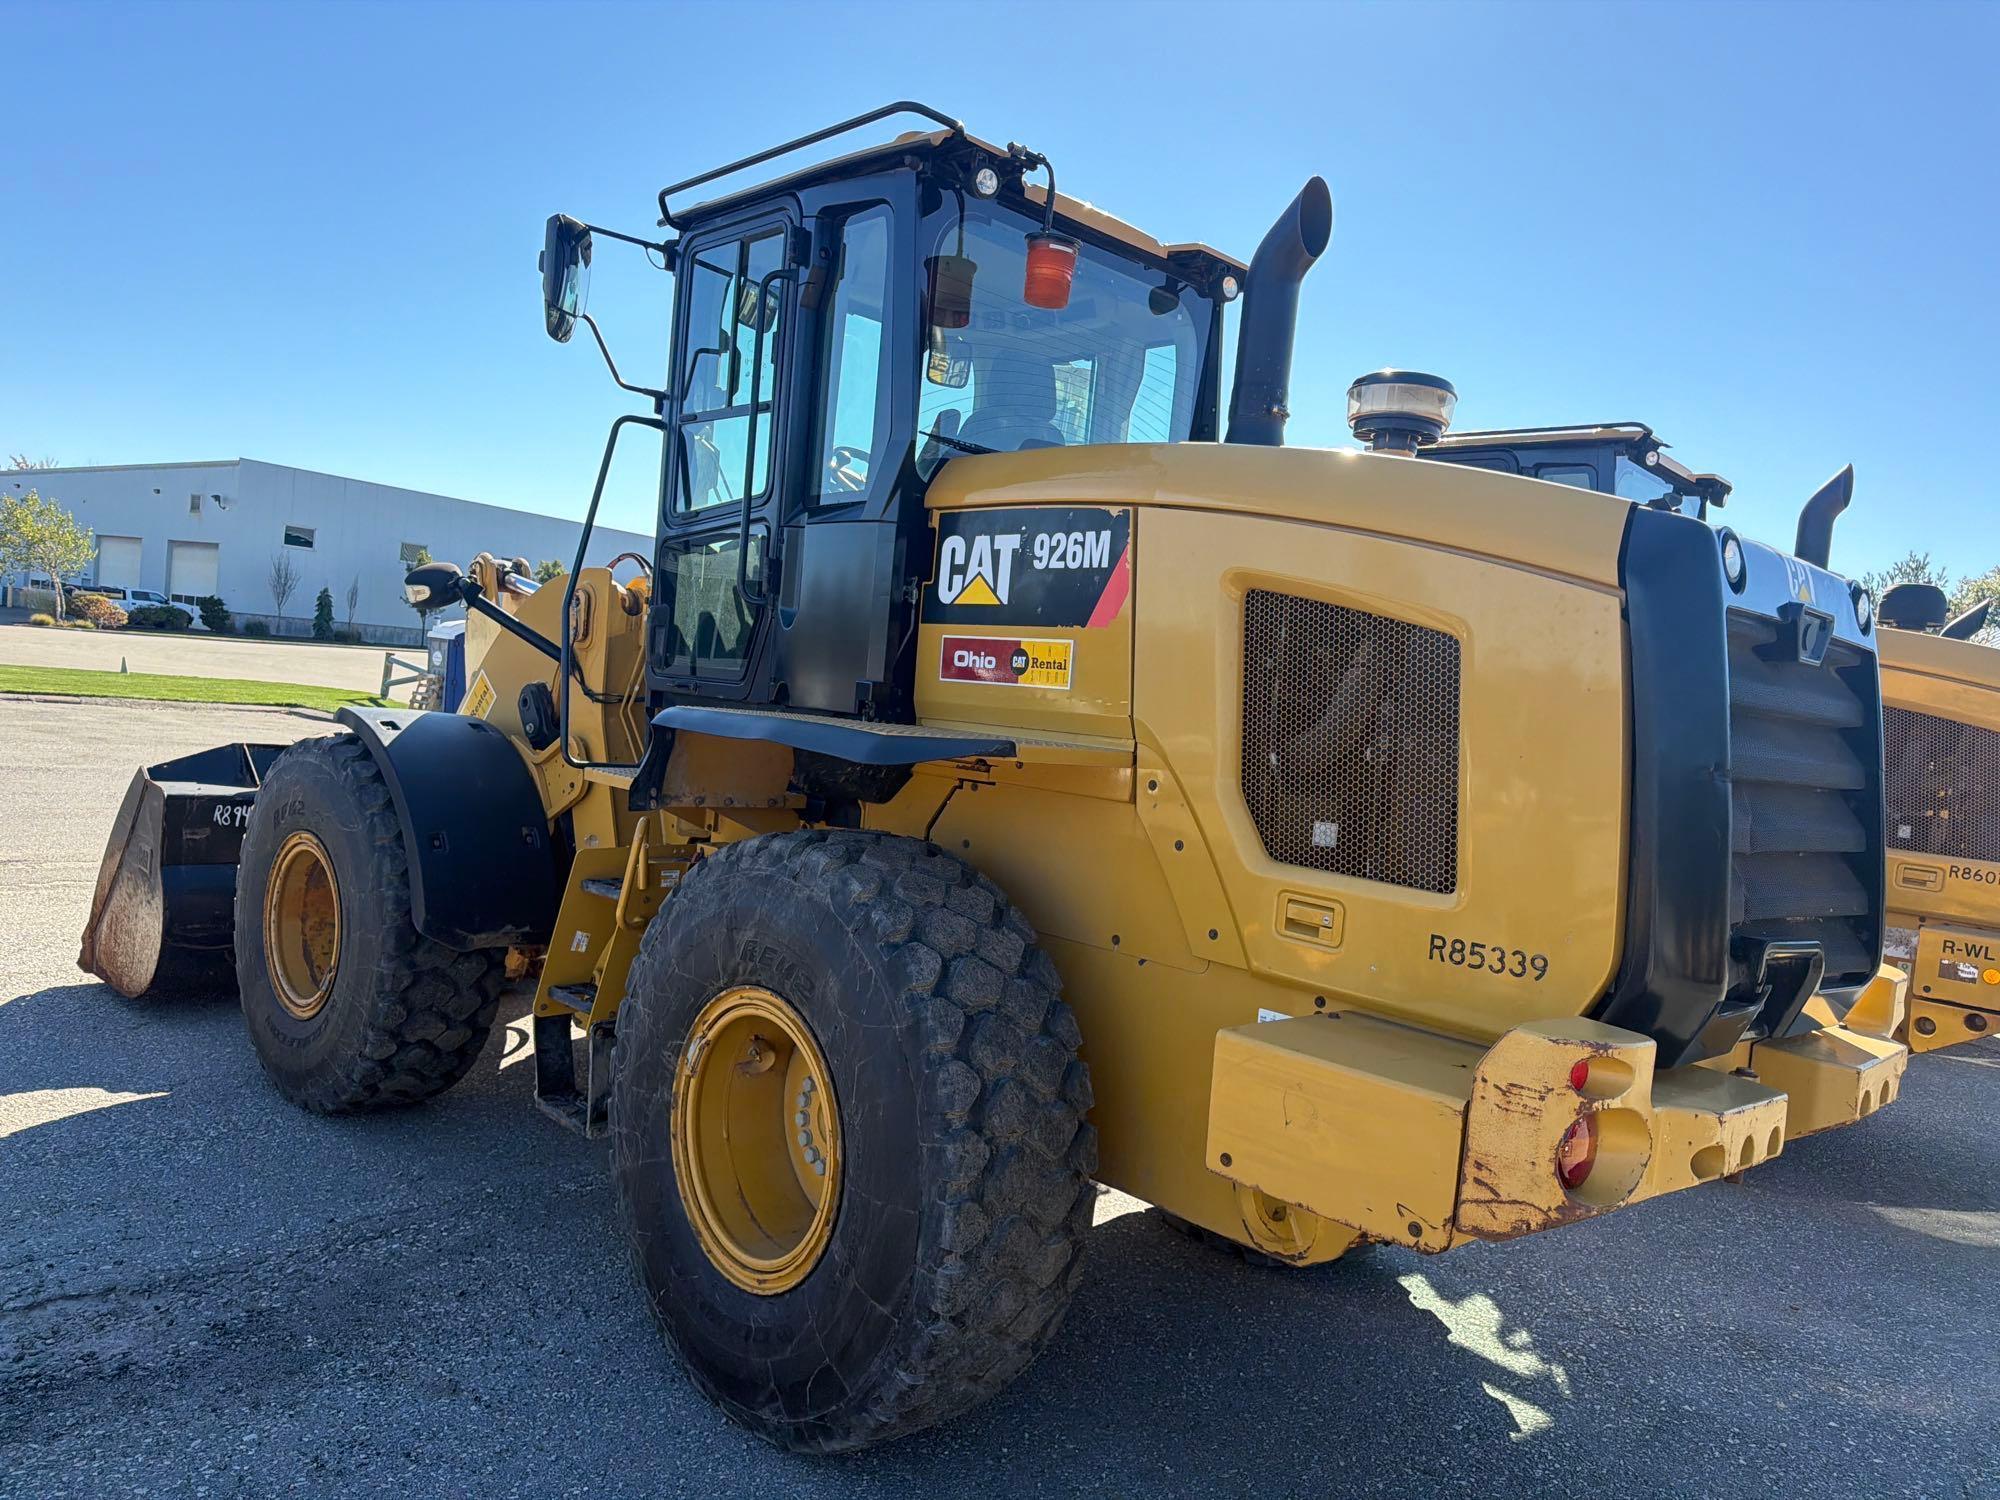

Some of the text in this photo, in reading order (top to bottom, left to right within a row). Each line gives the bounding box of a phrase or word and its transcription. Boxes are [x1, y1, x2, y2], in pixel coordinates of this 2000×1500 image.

[938, 530, 1112, 605] CAT 926M
[953, 650, 996, 669] Ohio
[1012, 656, 1027, 668] CAT
[1031, 657, 1067, 671] Rental
[1949, 864, 2000, 886] R860
[1428, 933, 1549, 982] R85339
[1942, 939, 1996, 961] R-WL
